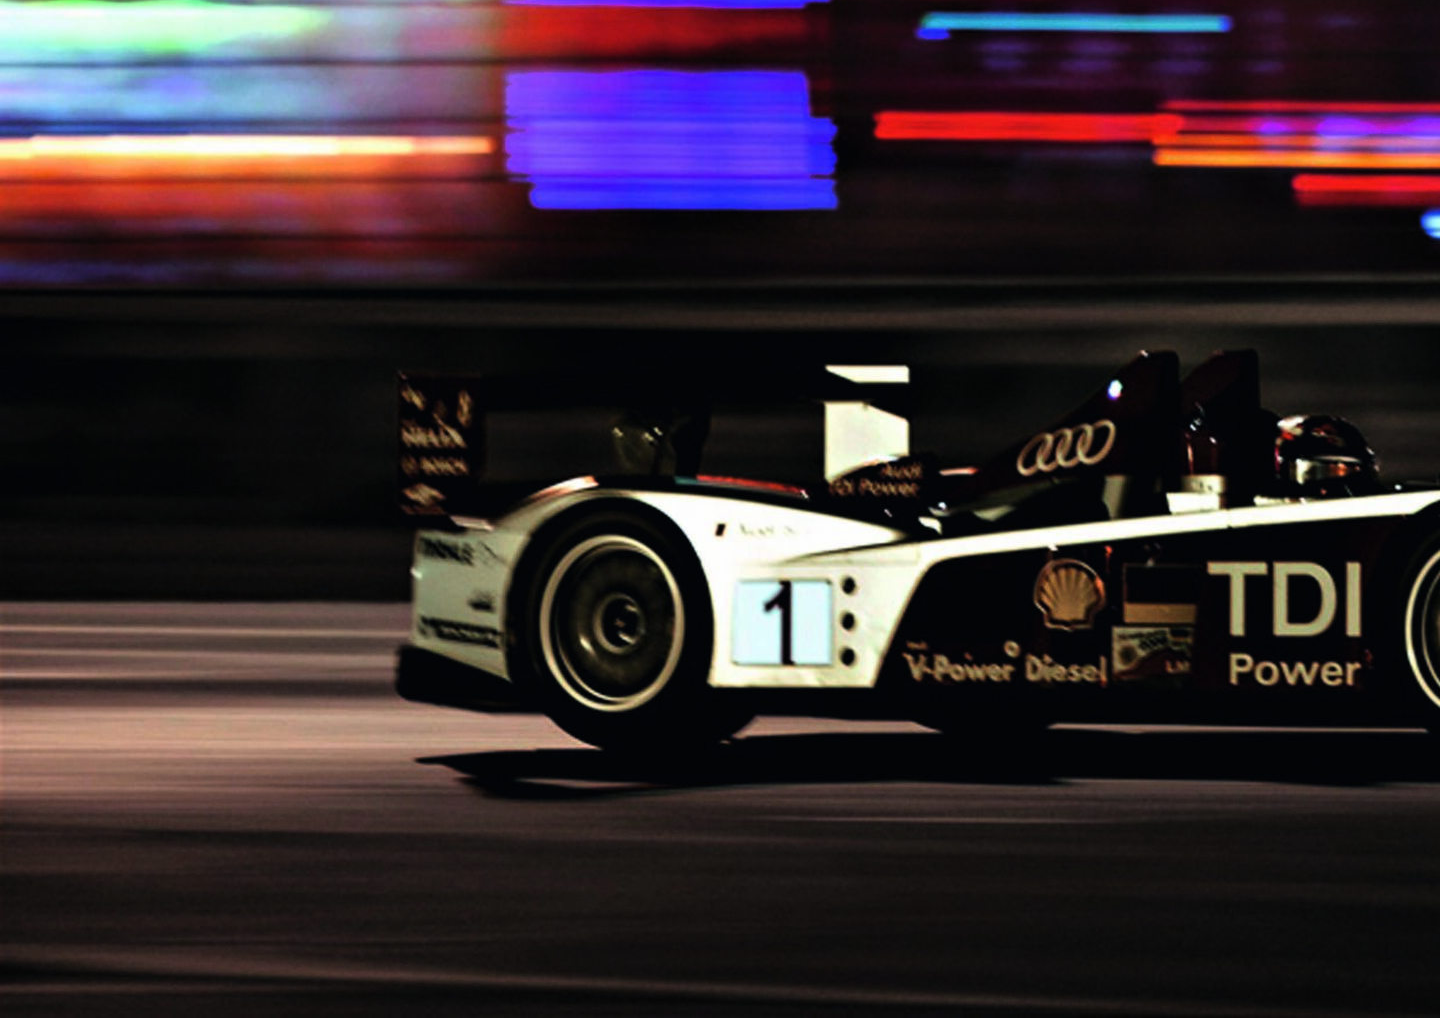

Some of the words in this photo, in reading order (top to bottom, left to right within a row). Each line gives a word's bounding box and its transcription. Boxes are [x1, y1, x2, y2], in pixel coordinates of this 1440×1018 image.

[763, 580, 796, 666] 1
[1206, 560, 1362, 637] TDI
[901, 652, 1016, 683] V-Power
[1024, 651, 1108, 688] Diesel
[1228, 652, 1362, 687] Power
